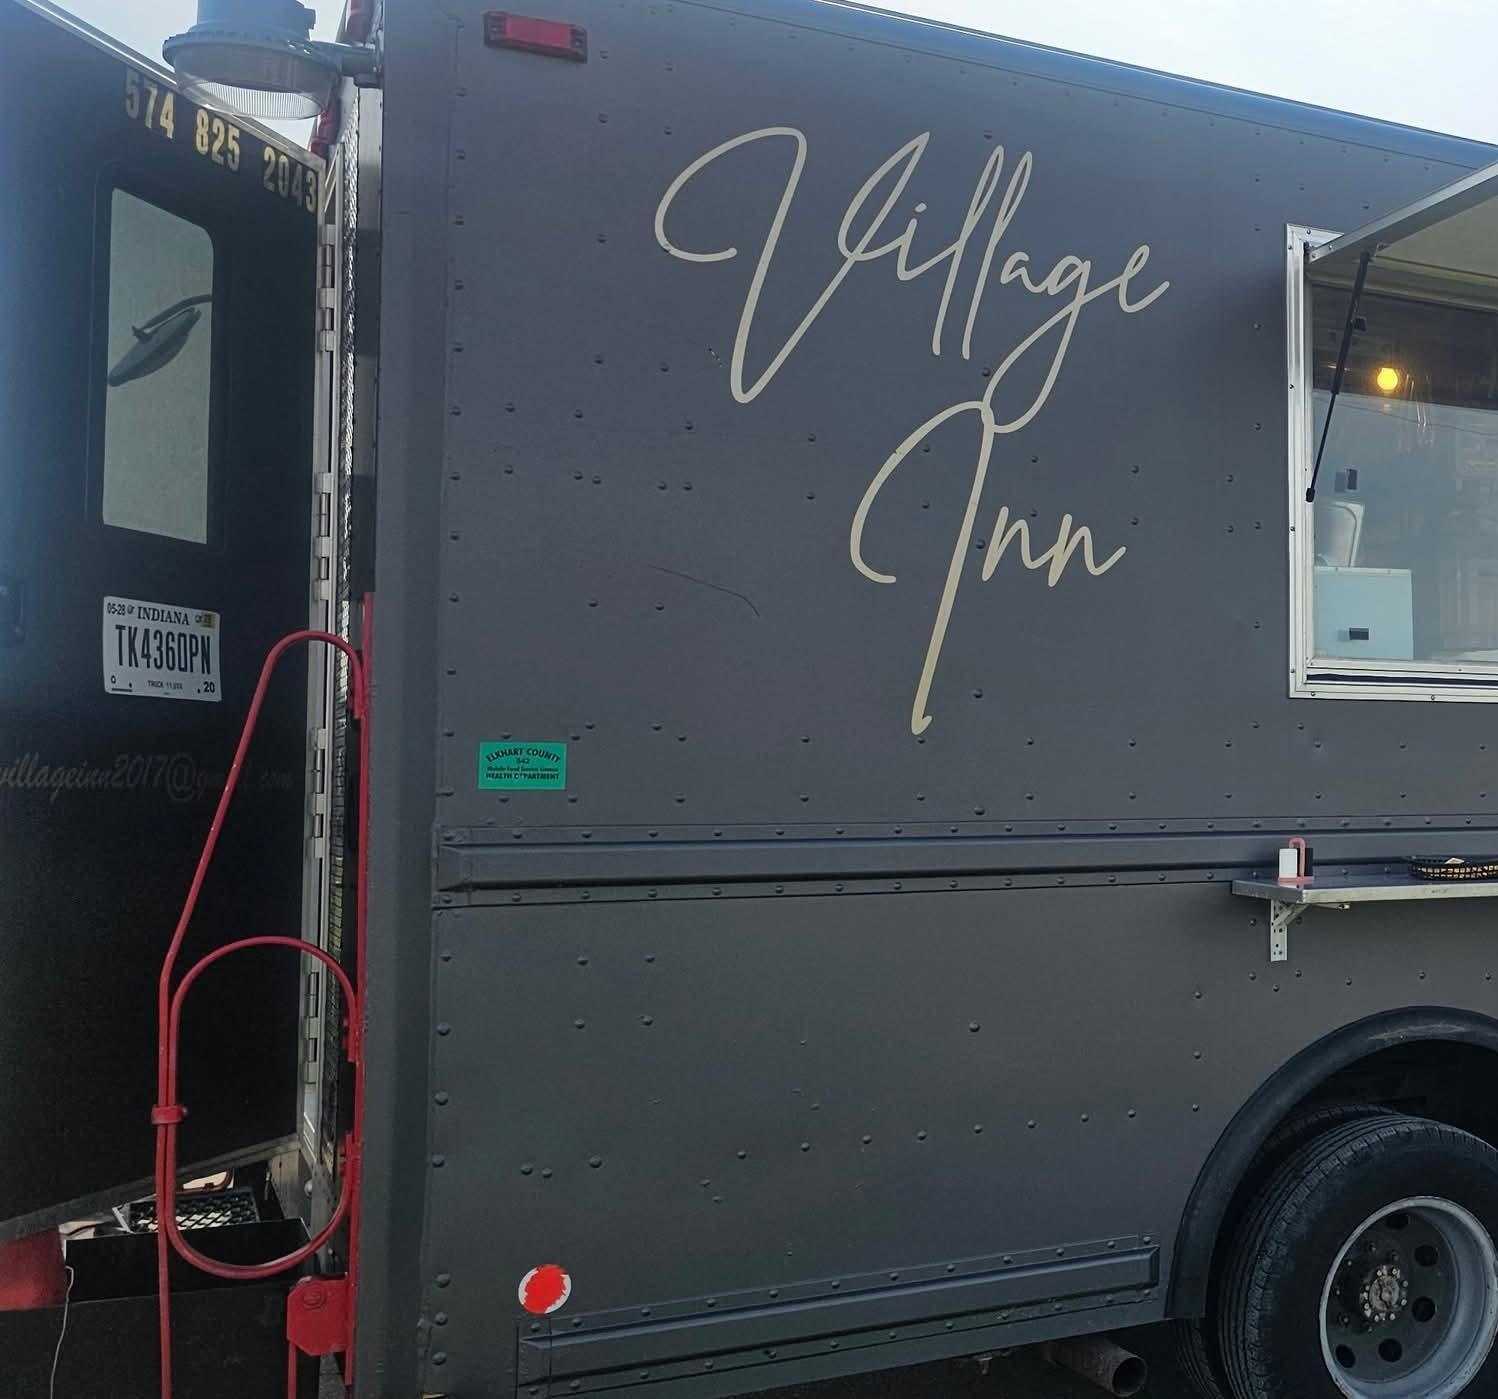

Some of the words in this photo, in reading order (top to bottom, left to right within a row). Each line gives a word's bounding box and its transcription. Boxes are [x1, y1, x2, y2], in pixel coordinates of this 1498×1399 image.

[126, 71, 175, 139] 574
[195, 108, 240, 172] 825
[263, 146, 317, 213] 2043
[654, 126, 1170, 434] Village
[850, 400, 1126, 735] Inn
[137, 606, 191, 626] INDIANA
[203, 681, 216, 693] 20
[486, 747, 523, 763] ELKHART
[526, 747, 561, 763] COUNTY
